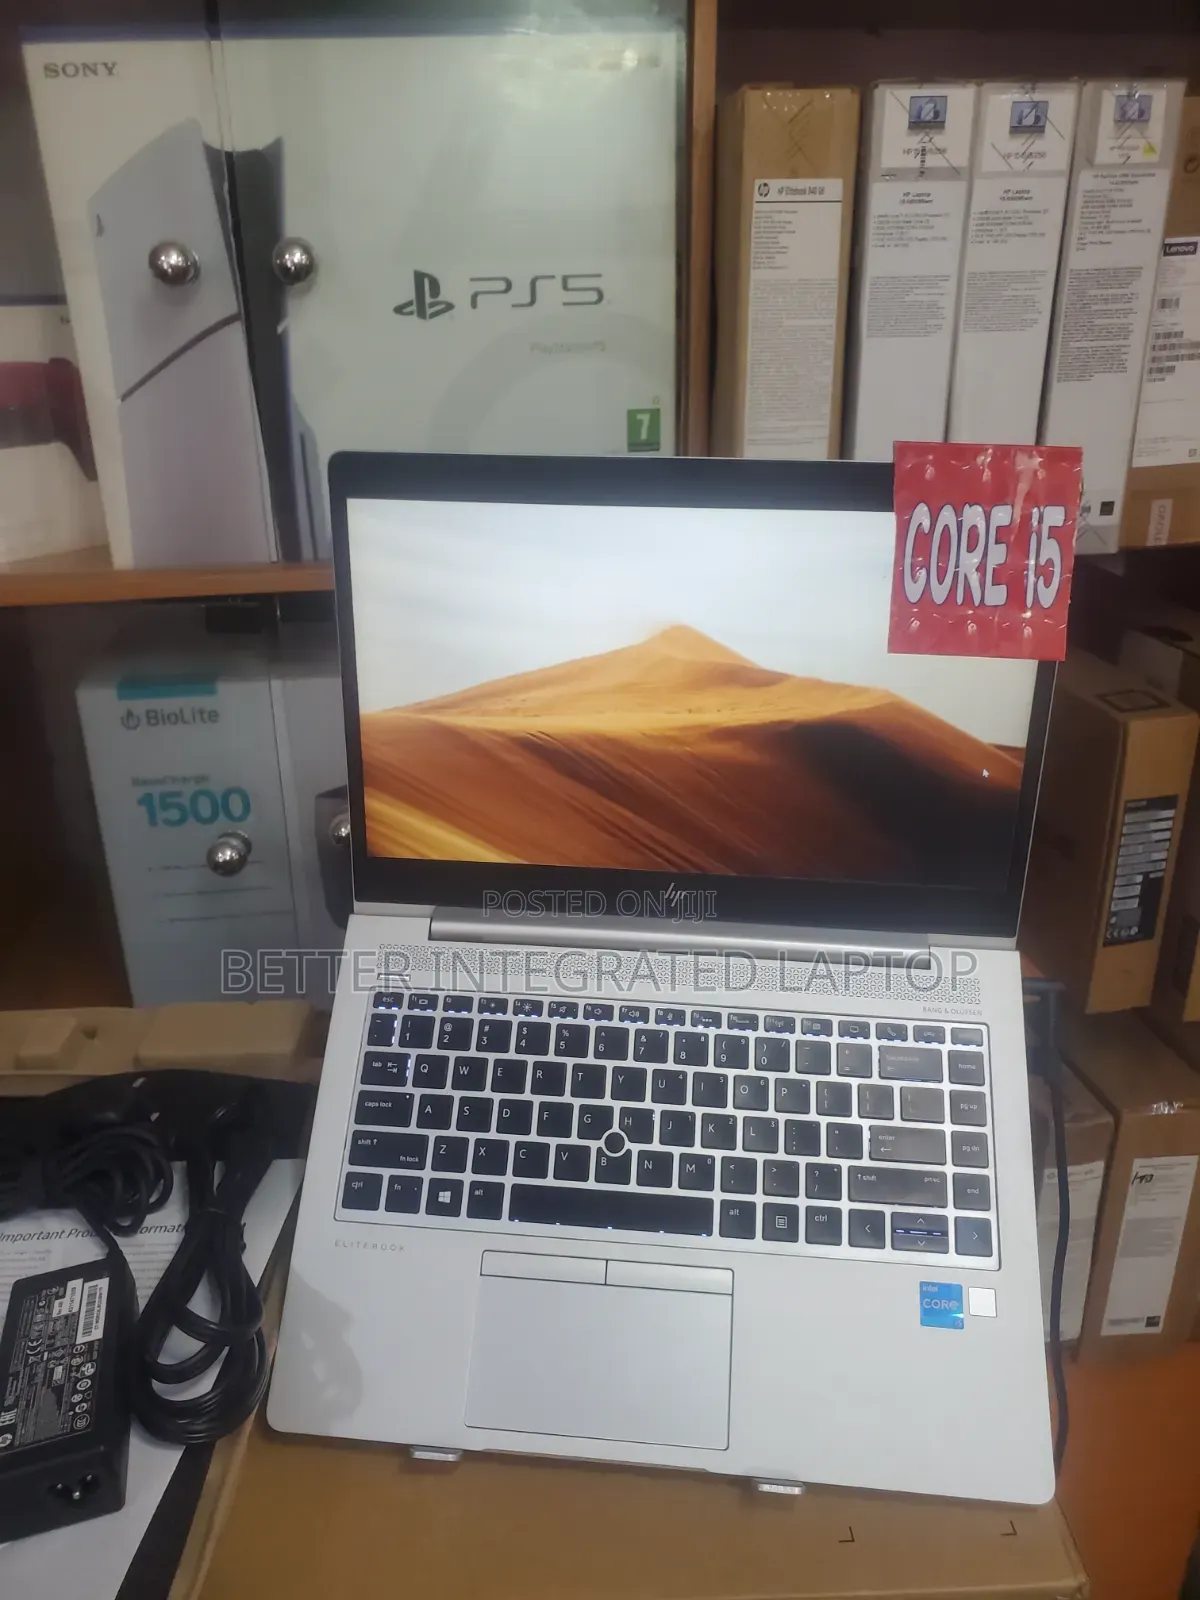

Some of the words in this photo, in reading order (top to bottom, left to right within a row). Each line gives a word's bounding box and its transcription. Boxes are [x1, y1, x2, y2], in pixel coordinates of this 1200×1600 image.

[43, 61, 117, 79] SONY
[1166, 244, 1195, 253] Lenovo
[469, 274, 604, 310] PS5
[636, 413, 651, 440] 7
[903, 501, 1013, 608] CORE
[145, 706, 220, 727] BioLite
[137, 786, 252, 828] 1500
[922, 1006, 942, 1014] BANG
[424, 1105, 432, 1114] A
[463, 1106, 470, 1116] S
[502, 1108, 511, 1118] D
[543, 1111, 549, 1121] F
[583, 1114, 592, 1124] G
[624, 1116, 632, 1126] H
[667, 1120, 672, 1130] J
[708, 1124, 715, 1133] K
[750, 1127, 756, 1136] L
[814, 1214, 828, 1222] ctrl
[0, 1228, 66, 1244] Important
[334, 1239, 404, 1252] ELITEBOOK
[922, 1284, 938, 1293] intel
